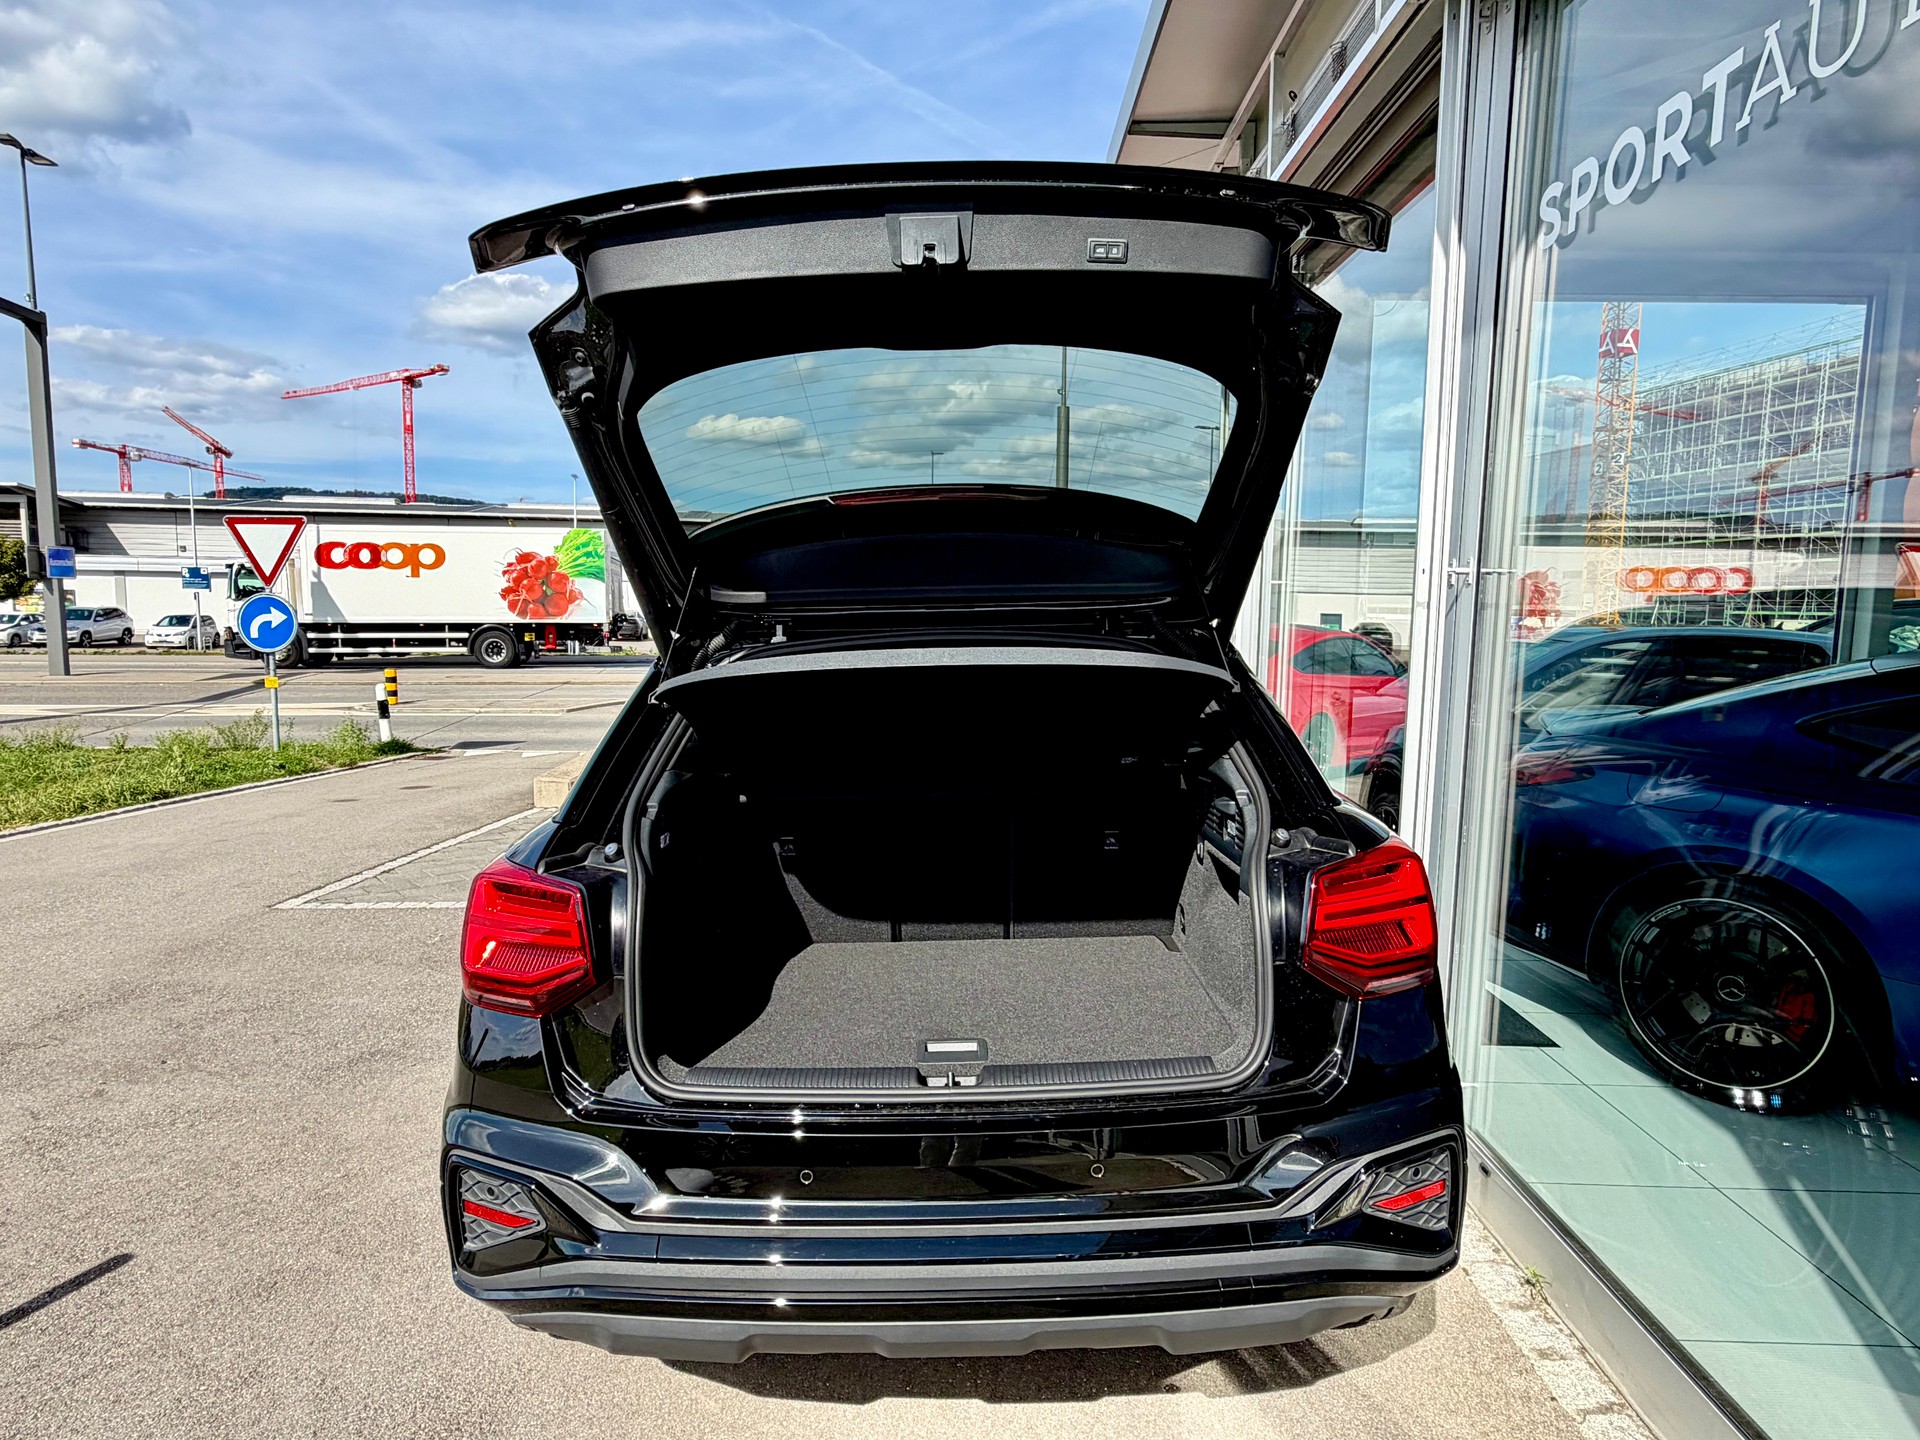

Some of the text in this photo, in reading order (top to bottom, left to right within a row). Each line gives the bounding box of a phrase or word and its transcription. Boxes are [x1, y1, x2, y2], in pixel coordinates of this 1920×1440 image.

[1538, 0, 1920, 249] SPORTAU
[1612, 453, 1623, 464] 2
[314, 541, 446, 578] coop
